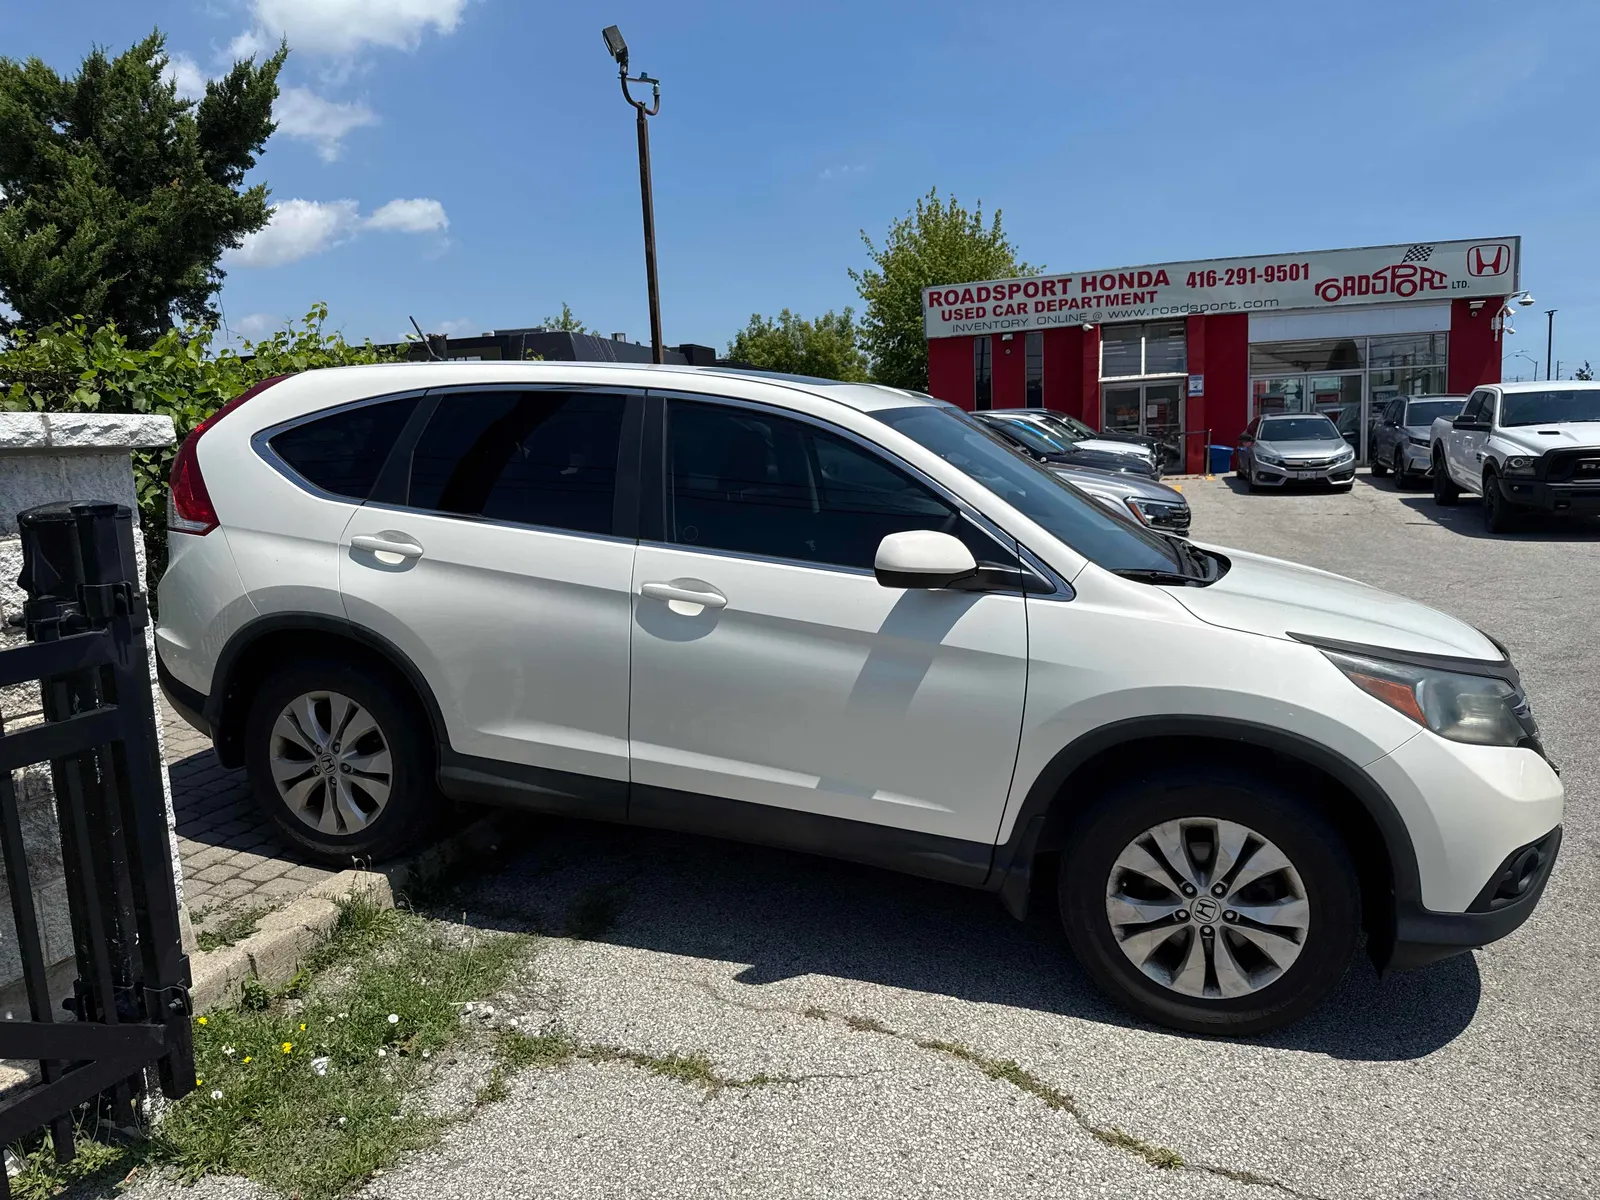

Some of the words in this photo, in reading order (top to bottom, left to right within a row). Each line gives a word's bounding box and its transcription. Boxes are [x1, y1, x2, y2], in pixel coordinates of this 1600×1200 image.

[928, 279, 1072, 307] ROADSPORT
[1081, 269, 1170, 292] HONDA
[1186, 263, 1309, 287] 416-291-9501
[941, 307, 987, 322] USED
[992, 302, 1028, 318] CAR
[1034, 291, 1158, 314] DEPARTMENT
[952, 318, 1029, 333] INVENTORY
[1036, 313, 1087, 326] ONLINE
[1092, 312, 1103, 322] @
